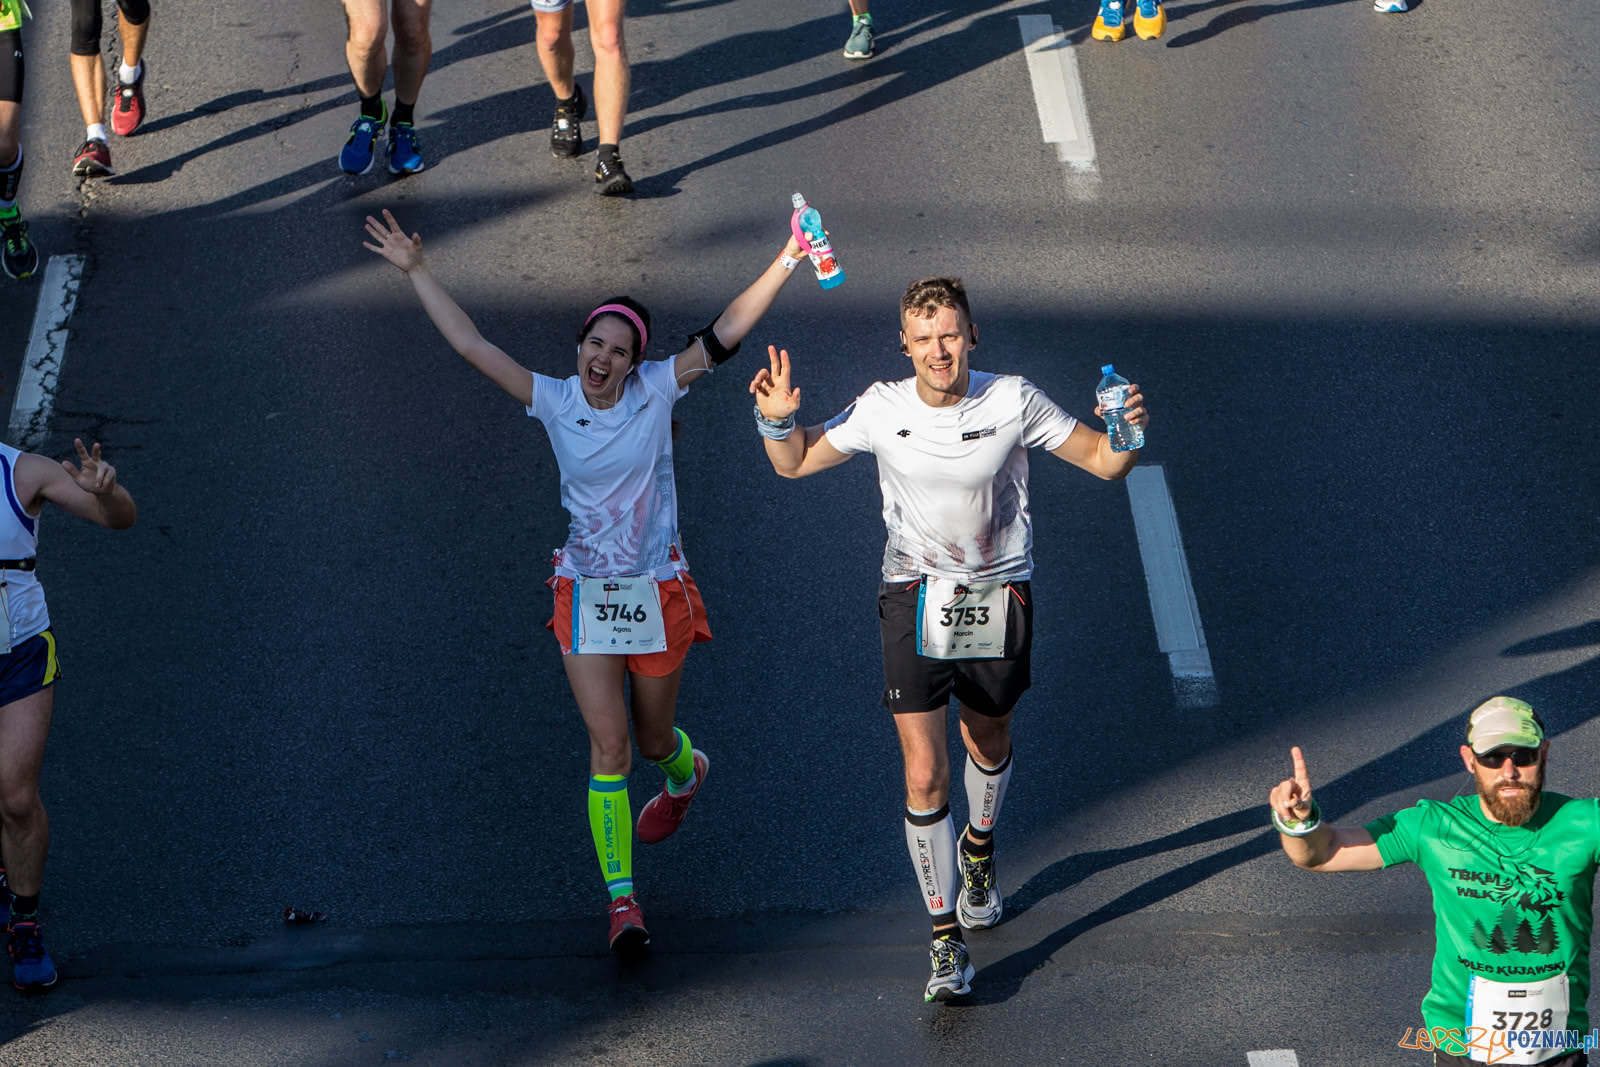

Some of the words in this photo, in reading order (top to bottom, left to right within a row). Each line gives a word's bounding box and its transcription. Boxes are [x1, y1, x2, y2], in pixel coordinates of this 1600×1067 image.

[594, 603, 647, 623] 3746
[940, 606, 990, 627] 3753
[1456, 886, 1499, 902] WILK
[1496, 960, 1566, 976] KUJAWSKI
[1492, 1008, 1553, 1031] 3728
